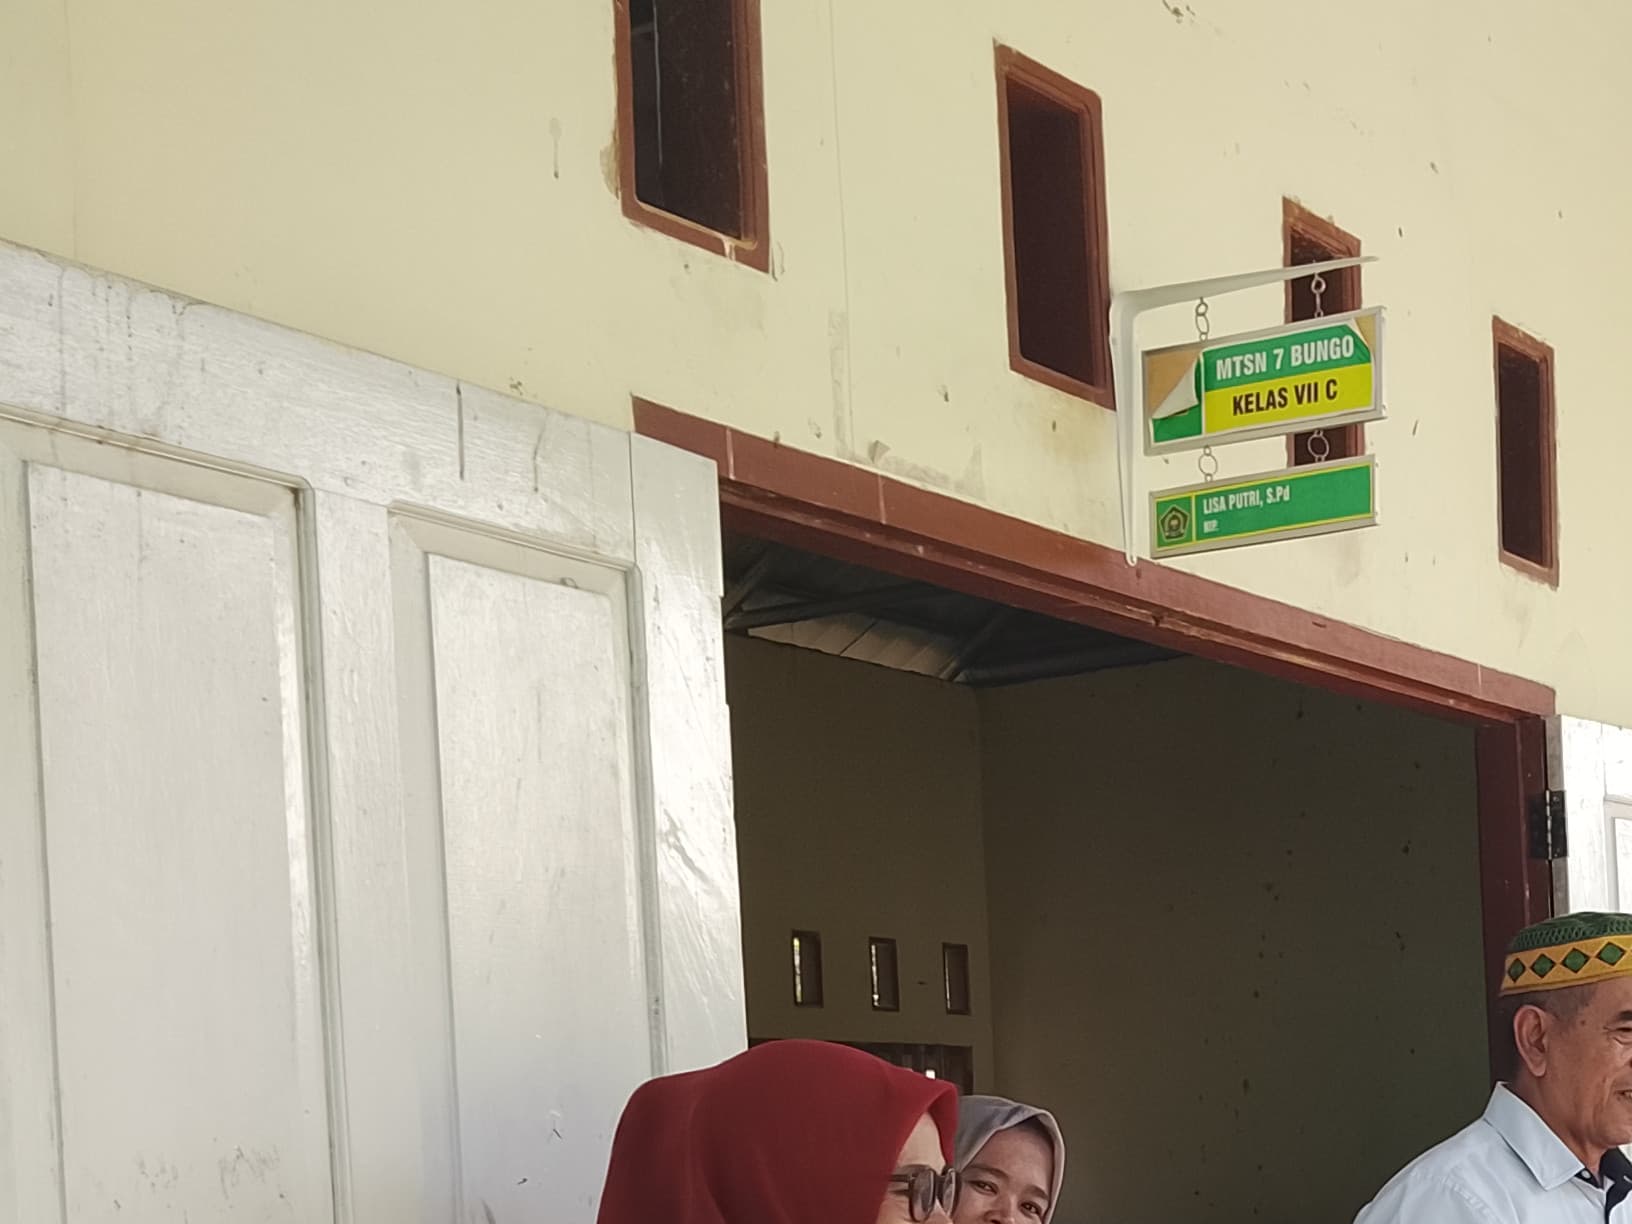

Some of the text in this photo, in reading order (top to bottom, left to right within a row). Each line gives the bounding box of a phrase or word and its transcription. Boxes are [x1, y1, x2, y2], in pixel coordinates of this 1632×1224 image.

[1216, 335, 1354, 380] MTSN 7 BUNGO
[1233, 379, 1337, 416] KELAS VII C
[1203, 485, 1290, 514] LISA PUTRI, S.Pd
